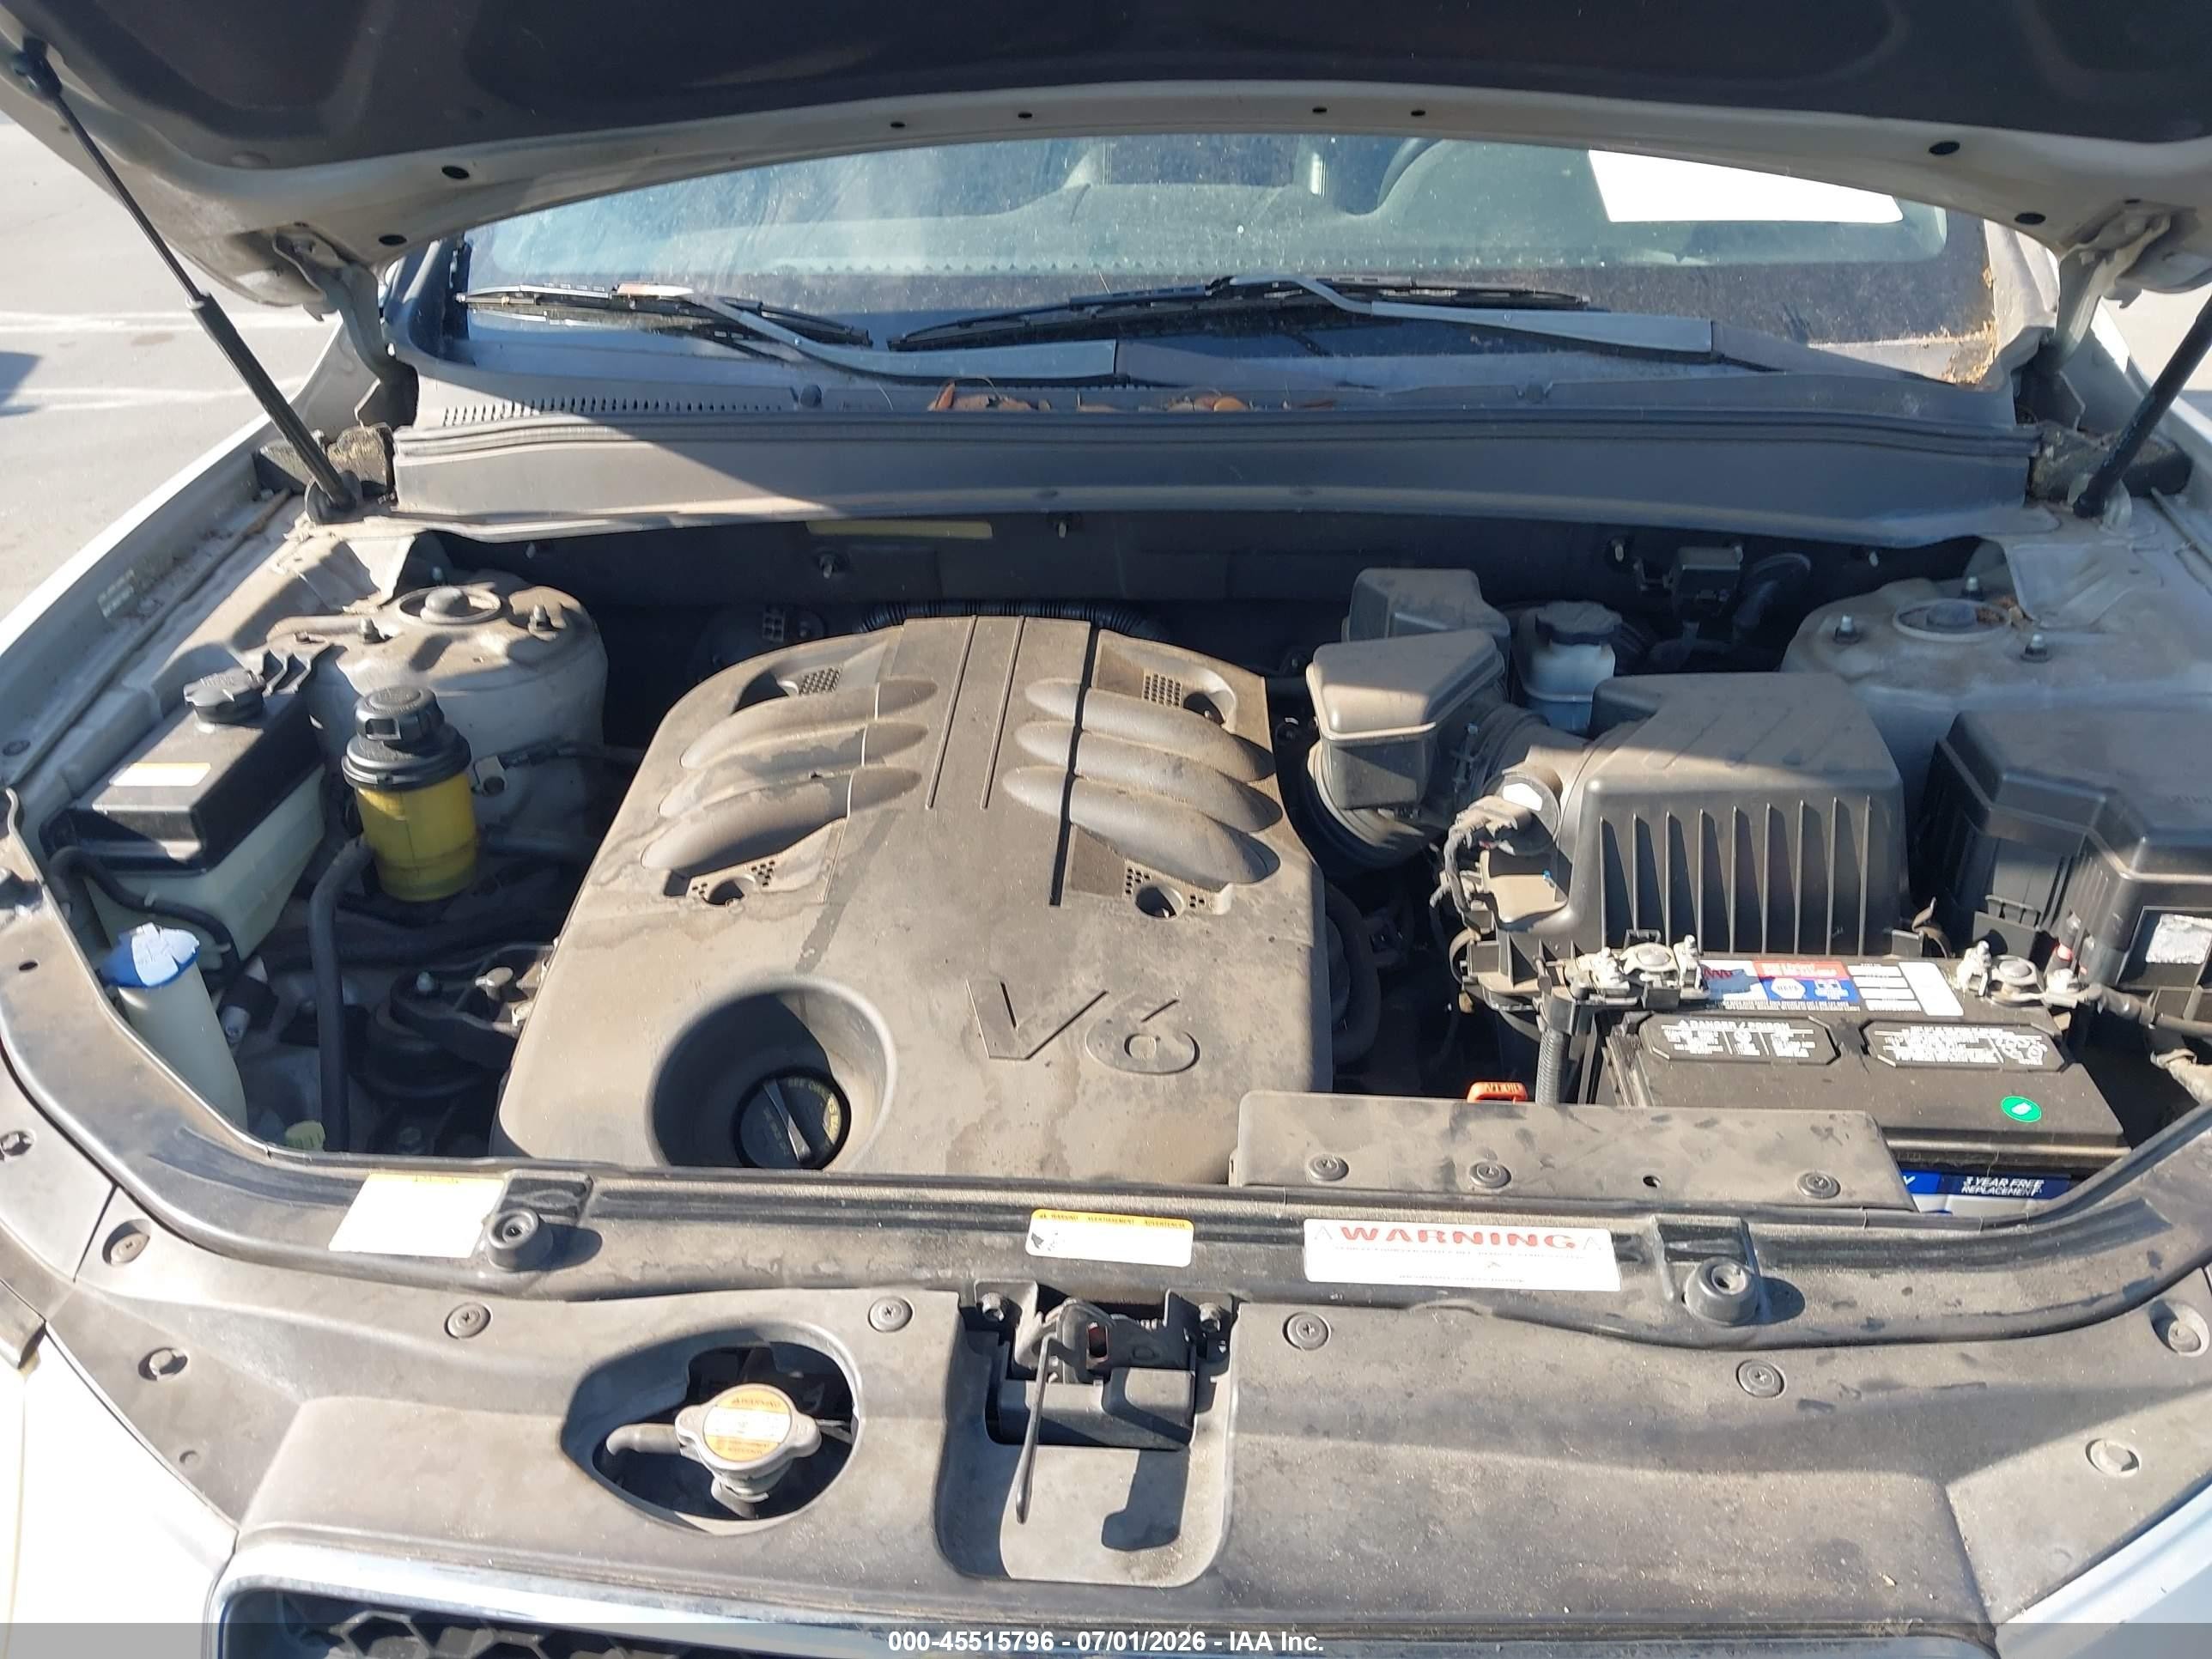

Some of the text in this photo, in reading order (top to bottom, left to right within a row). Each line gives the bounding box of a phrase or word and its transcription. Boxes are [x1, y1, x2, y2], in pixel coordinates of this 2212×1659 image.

[964, 978, 1200, 1076] V6
[1975, 1176, 2008, 1187] YEAR
[2009, 1178, 2045, 1188] FREE
[1340, 1225, 1576, 1249] WARNING
